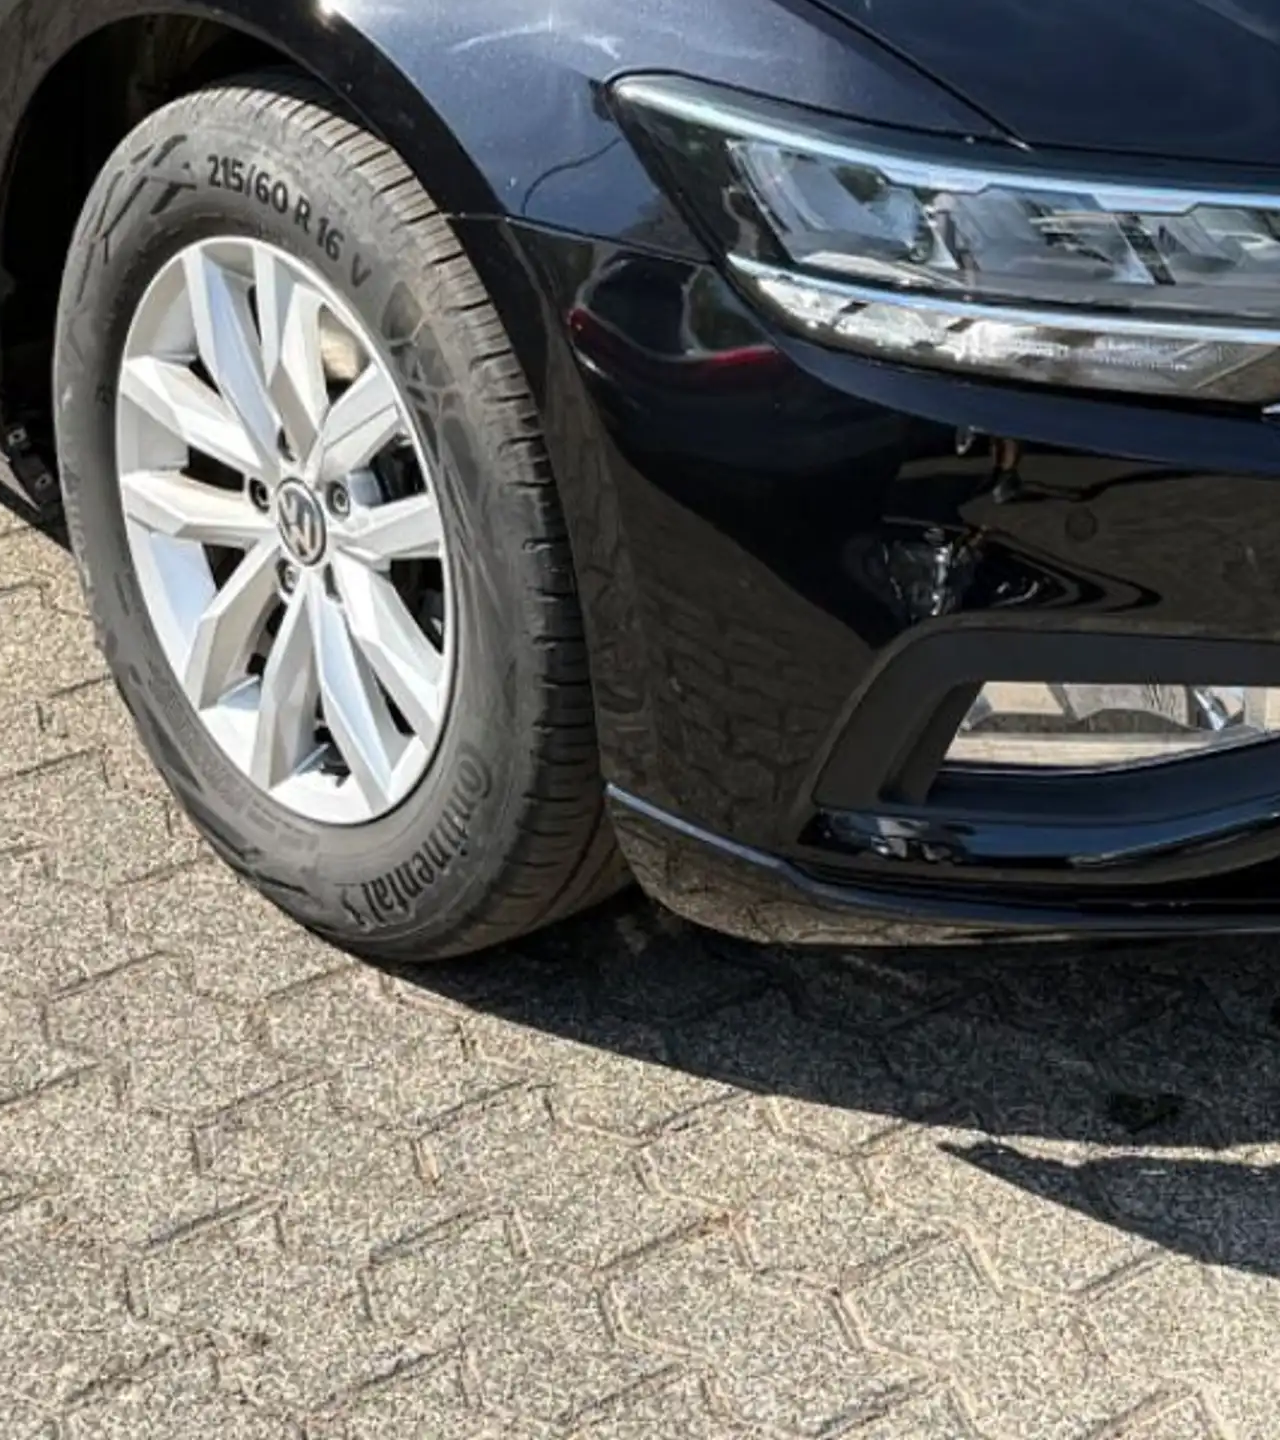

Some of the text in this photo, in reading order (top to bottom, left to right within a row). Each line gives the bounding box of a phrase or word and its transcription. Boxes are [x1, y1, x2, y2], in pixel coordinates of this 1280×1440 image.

[207, 153, 372, 288] 215/60 R 16 V
[360, 754, 492, 924] Continental
